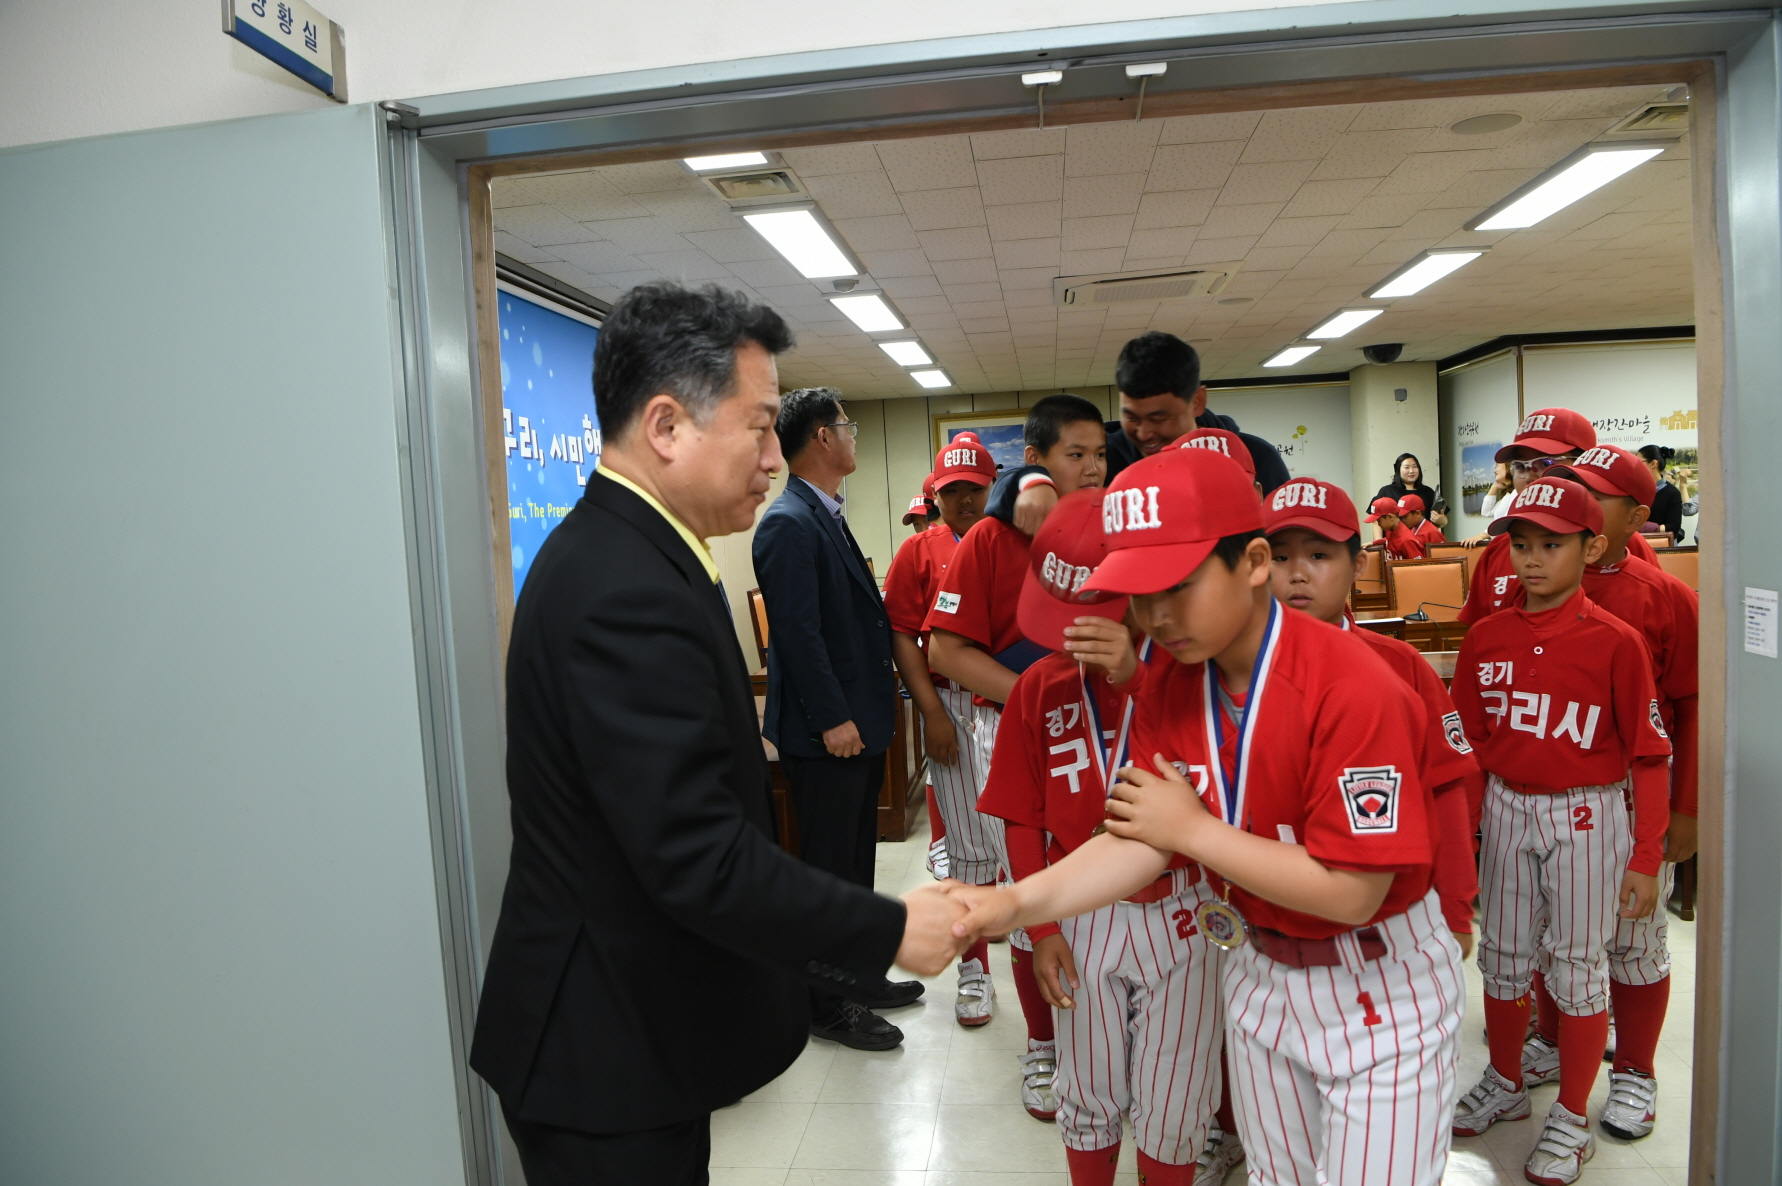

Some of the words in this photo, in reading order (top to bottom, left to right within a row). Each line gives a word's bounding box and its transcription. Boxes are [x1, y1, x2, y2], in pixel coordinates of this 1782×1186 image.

[1624, 435, 1644, 443] Village
[944, 449, 977, 467] GURI
[1573, 448, 1619, 470] GURI
[1272, 483, 1328, 512] GURI
[1514, 484, 1565, 509] GURI
[529, 503, 545, 517] The
[1103, 486, 1162, 535] GURI
[1042, 552, 1099, 593] GUR
[1494, 574, 1518, 595] 경
[1478, 661, 1513, 685] 경기
[1045, 701, 1085, 737] 경기
[1480, 690, 1601, 749] 구리시
[1573, 806, 1594, 831] 2
[1357, 991, 1382, 1026] 1
